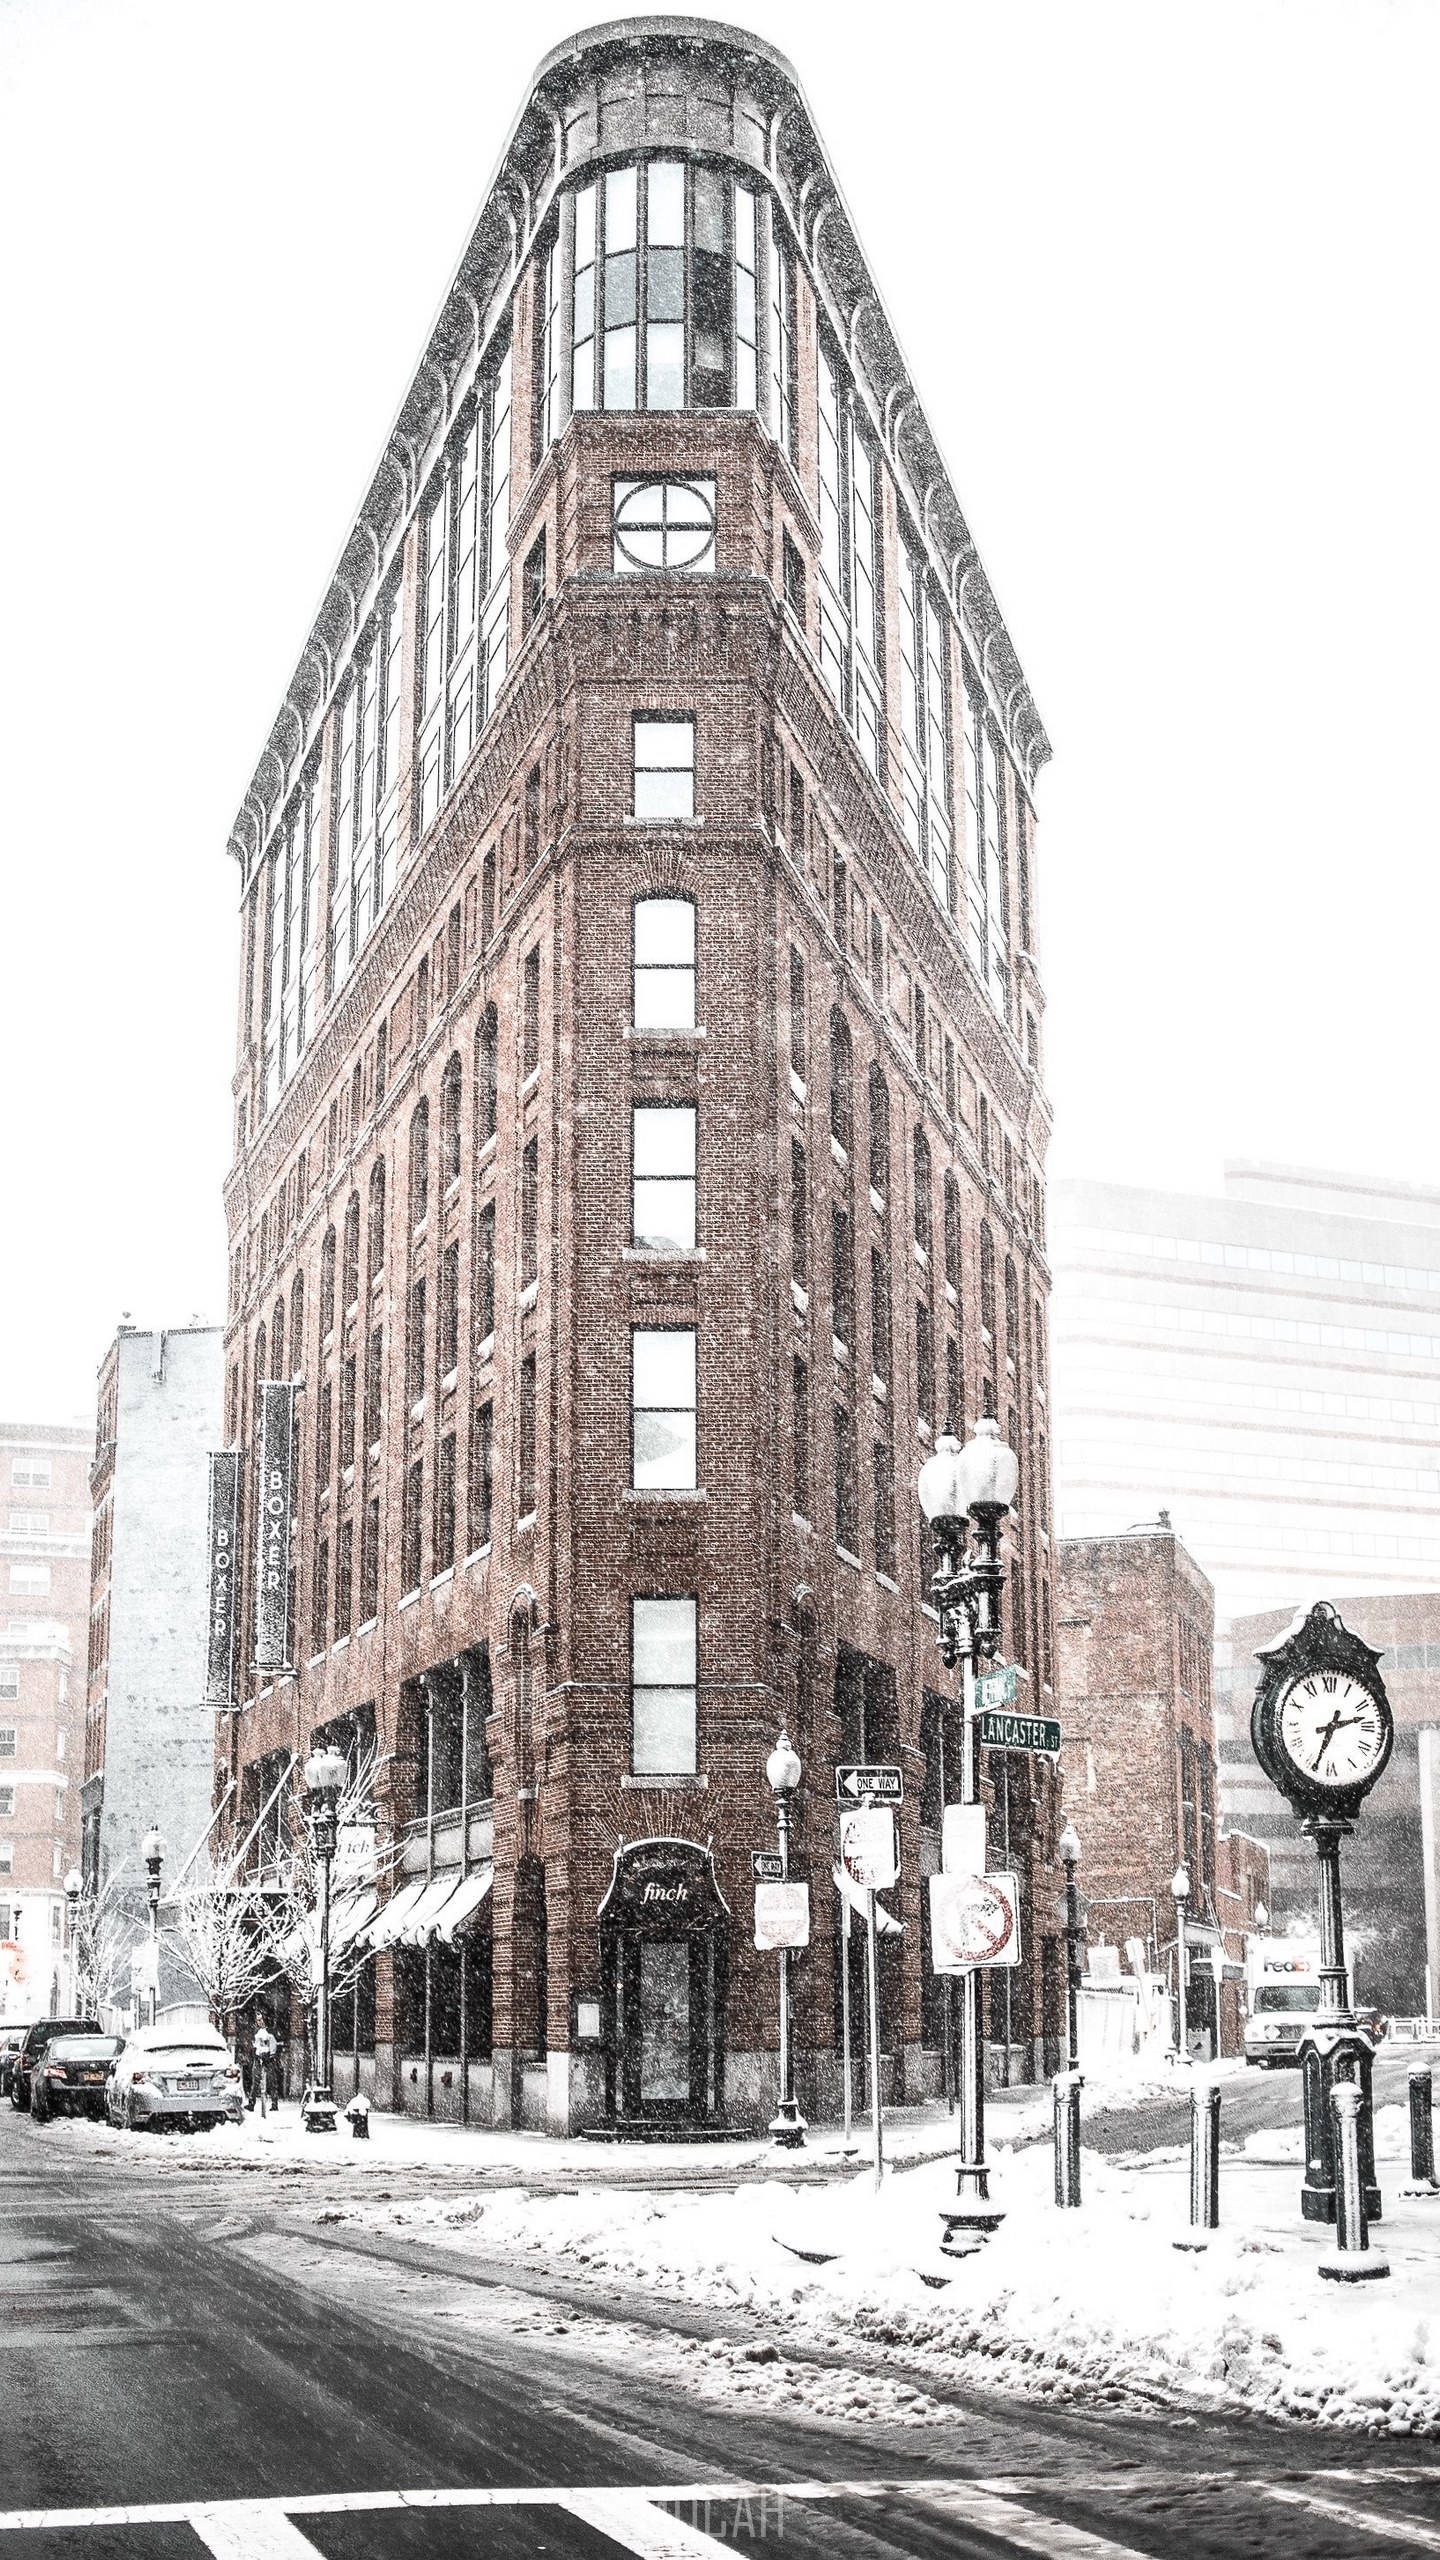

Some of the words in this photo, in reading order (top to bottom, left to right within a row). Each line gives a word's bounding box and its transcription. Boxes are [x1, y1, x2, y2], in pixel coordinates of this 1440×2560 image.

[266, 1470, 285, 1589] BOXER
[213, 1529, 230, 1636] BOXER
[1322, 1676, 1337, 1694] XII
[981, 1715, 1046, 1747] LANCASTER
[1051, 1736, 1058, 1748] ST
[856, 1777, 874, 1790] ONE
[878, 1777, 896, 1791] WAY
[640, 1882, 688, 1905] finch
